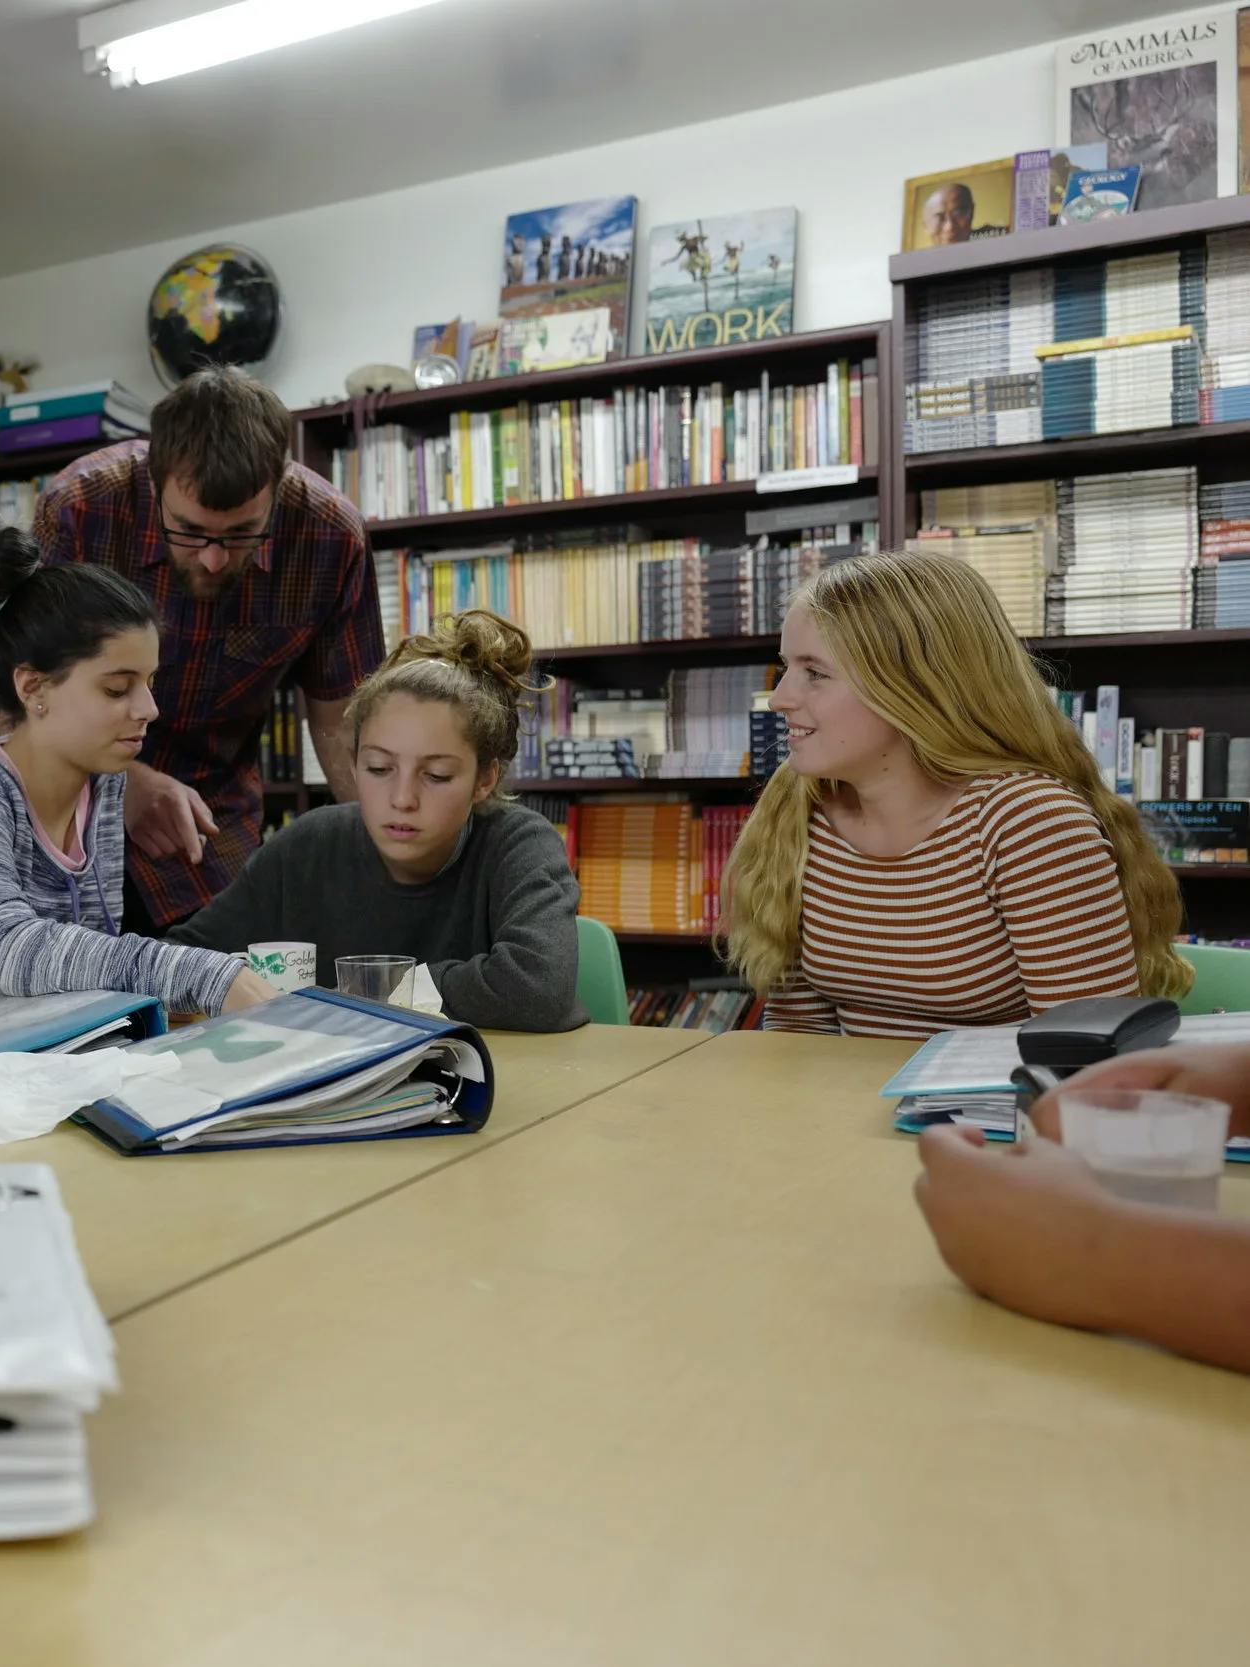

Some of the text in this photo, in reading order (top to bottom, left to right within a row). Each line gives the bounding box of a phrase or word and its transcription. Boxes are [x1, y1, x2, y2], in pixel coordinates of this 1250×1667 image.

[1070, 21, 1218, 65] MAMMALS
[1092, 47, 1194, 77] OF AMERICA
[646, 303, 786, 355] WORK
[1141, 802, 1241, 812] POWERS OF TEN
